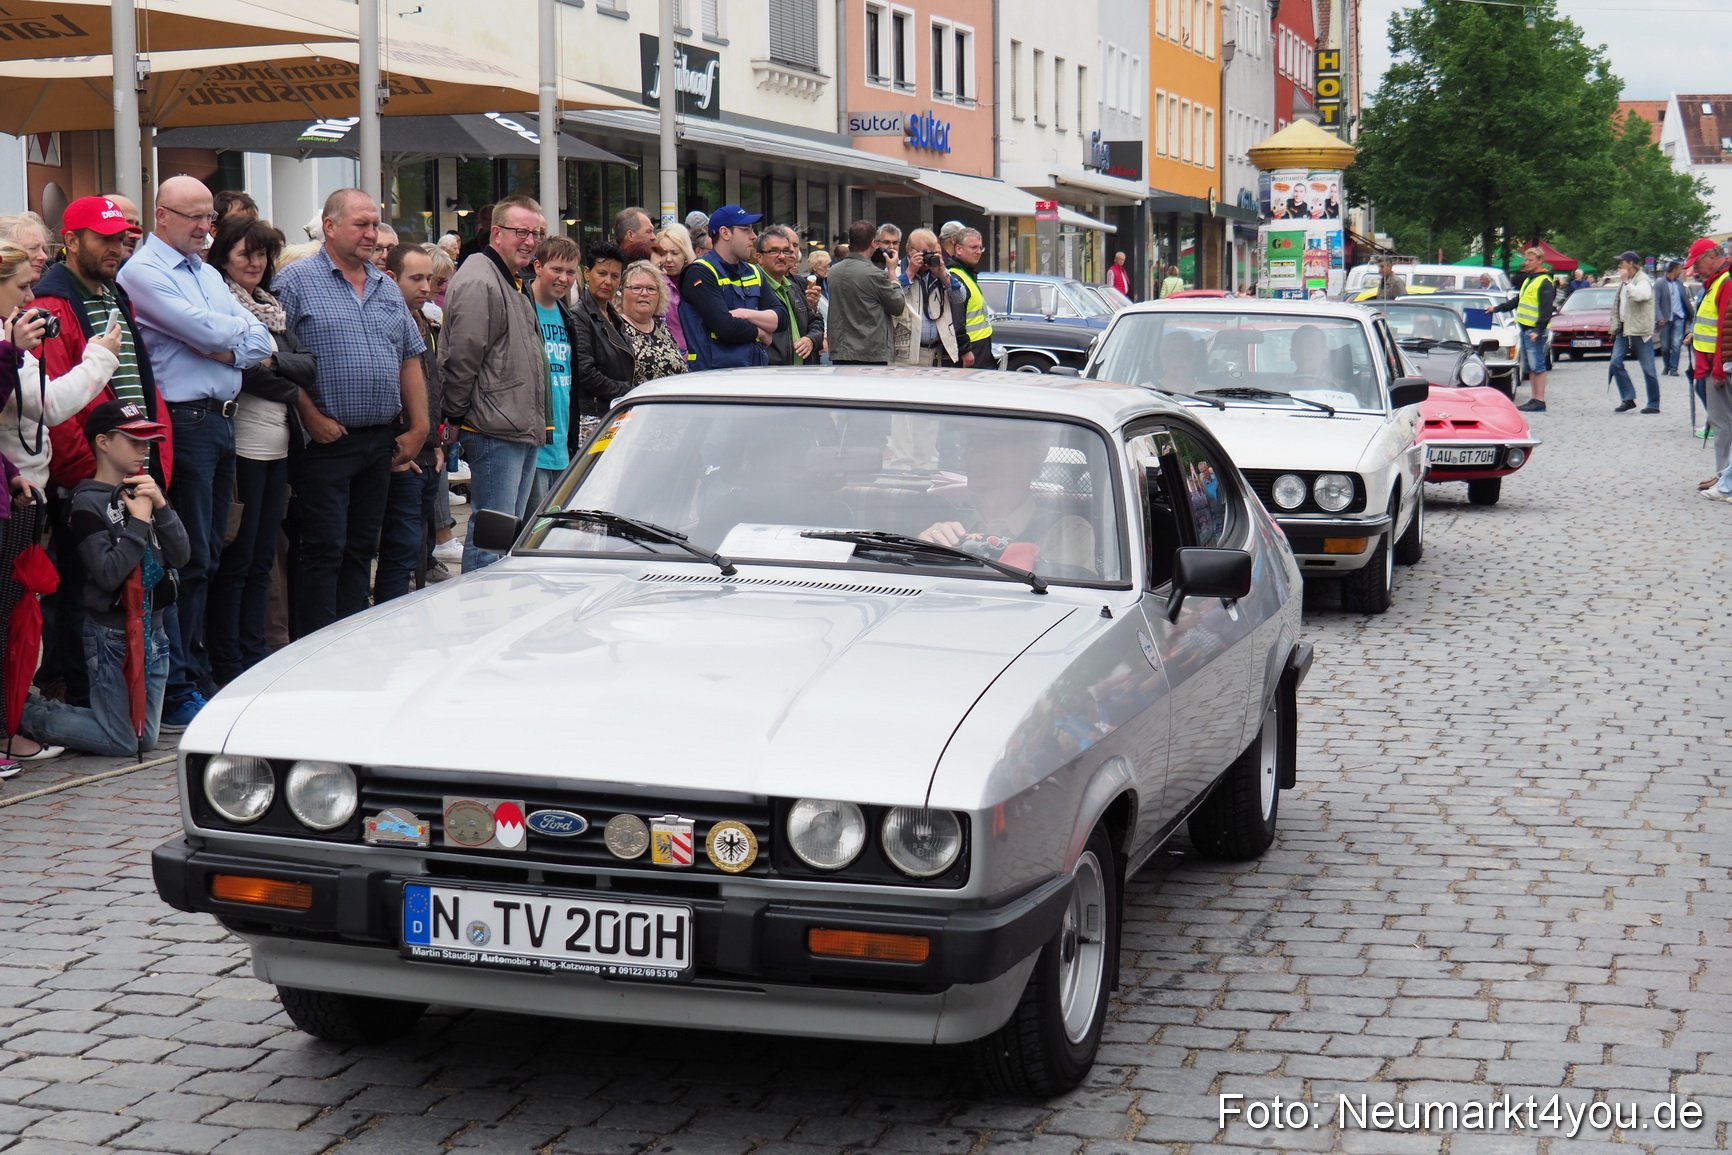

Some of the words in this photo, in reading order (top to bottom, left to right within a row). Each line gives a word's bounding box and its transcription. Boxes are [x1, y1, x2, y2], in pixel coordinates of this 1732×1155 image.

[1317, 51, 1340, 136] HOT
[1429, 449, 1452, 463] LAU
[540, 814, 573, 831] Ford
[413, 920, 423, 933] D
[432, 894, 460, 940] N
[493, 900, 552, 948] TV
[565, 906, 685, 961] 200H
[412, 947, 440, 958] Martin
[442, 950, 478, 962] Staudigl
[480, 953, 531, 966] Automobile
[540, 960, 600, 974] Nbg.-Katzwang
[656, 970, 667, 978] 53
